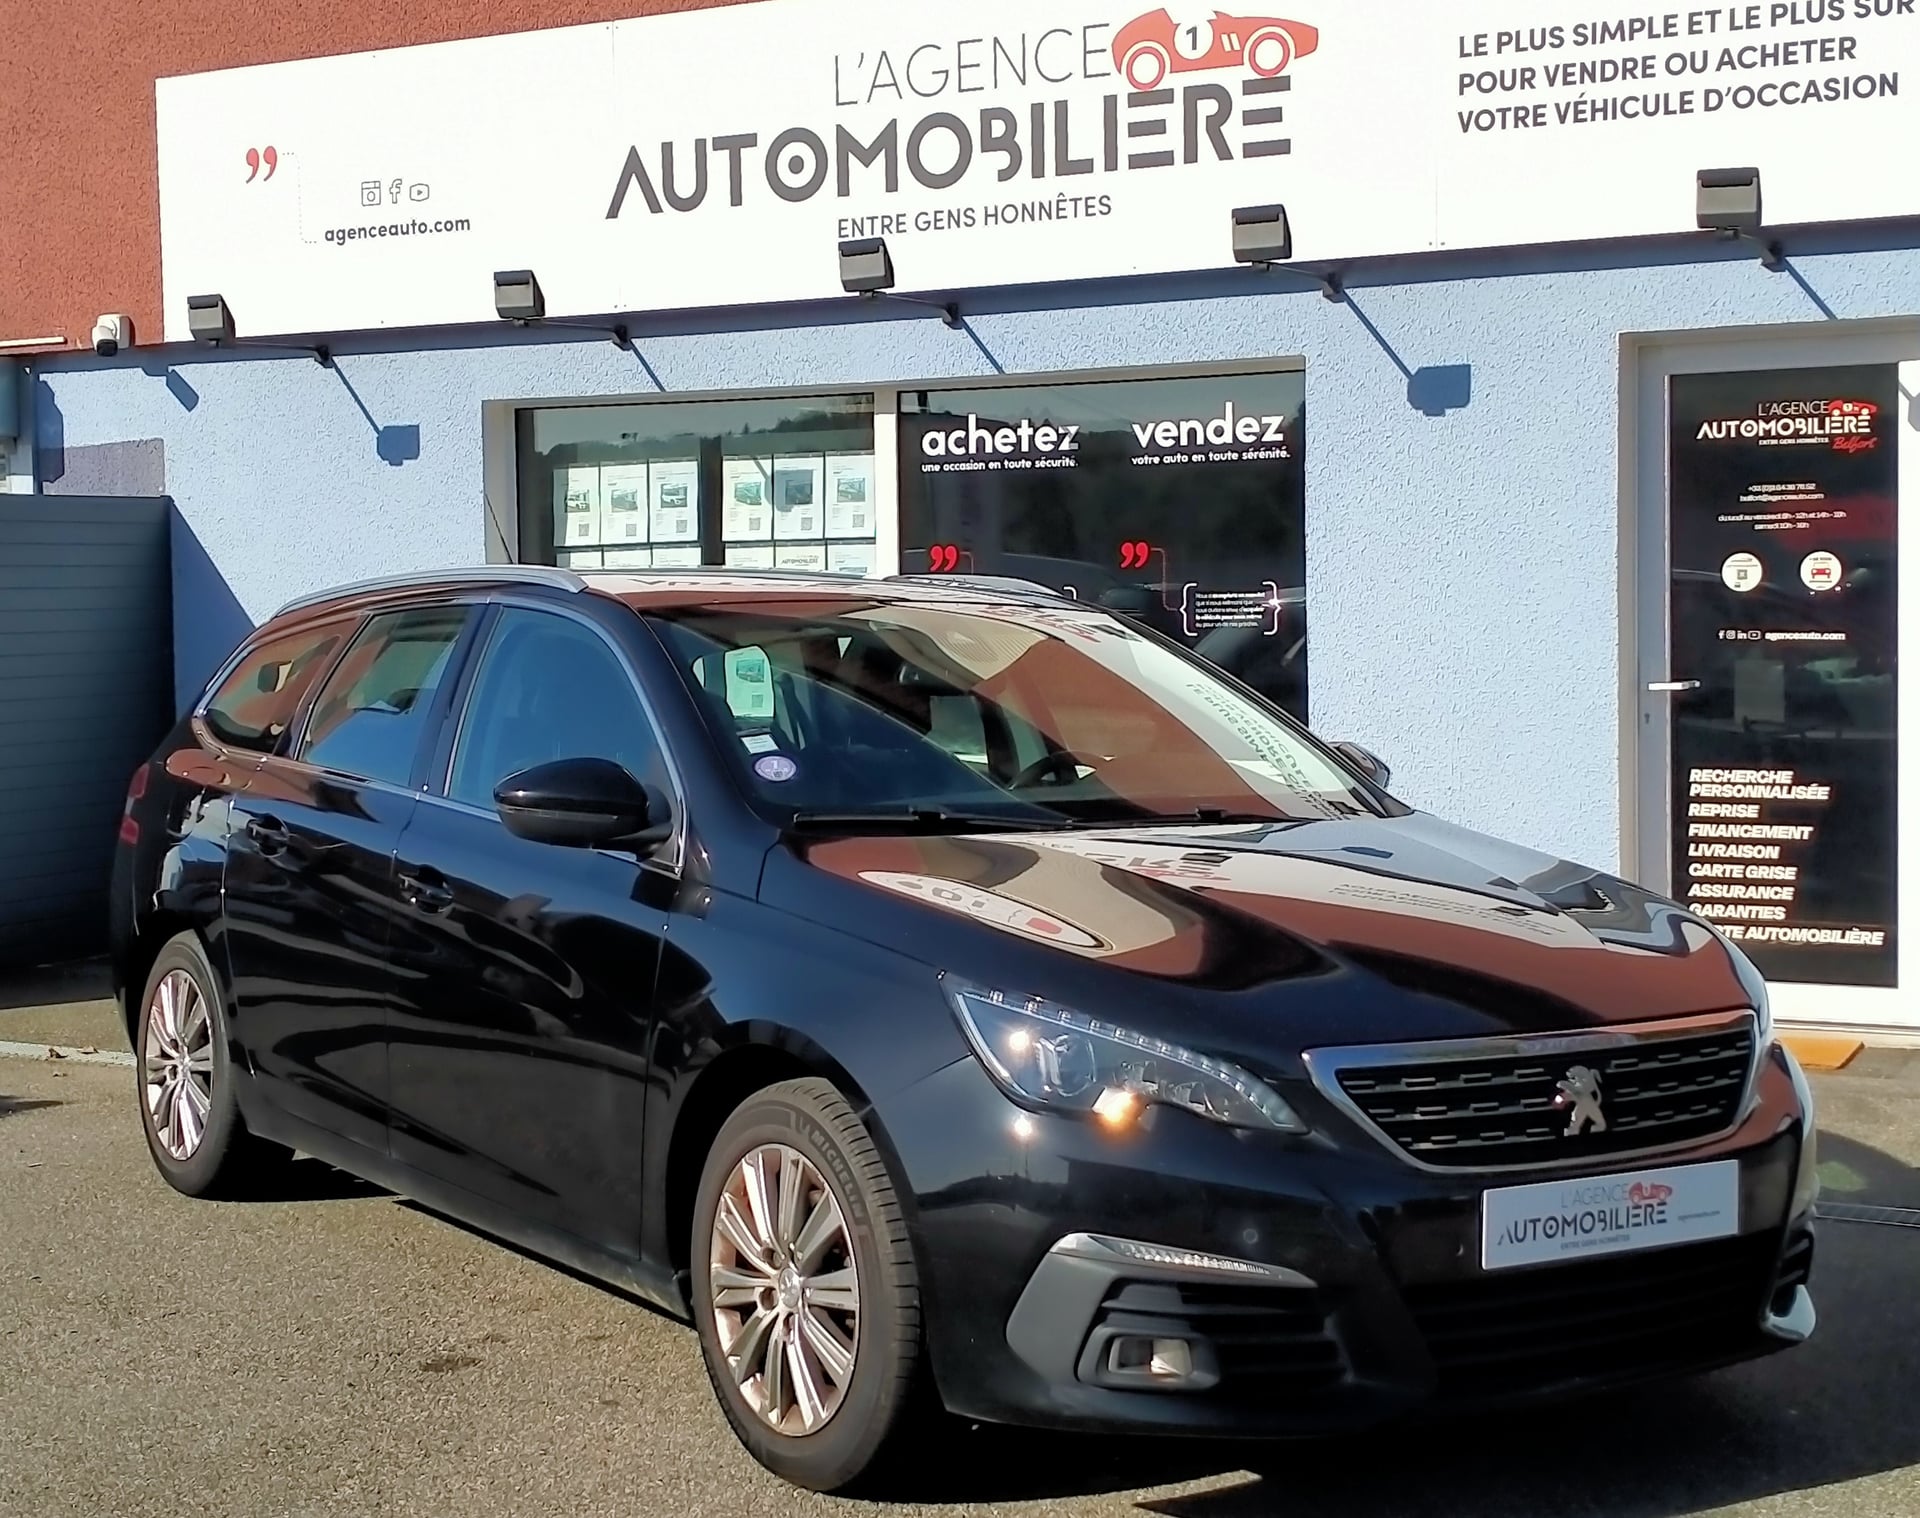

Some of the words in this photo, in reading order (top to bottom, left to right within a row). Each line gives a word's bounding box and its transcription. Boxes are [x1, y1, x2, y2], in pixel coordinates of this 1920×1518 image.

[1459, 33, 1489, 58] LE
[1496, 27, 1565, 54] PLUS
[1572, 14, 1679, 48] SIMPLE
[1687, 9, 1722, 36] ET
[1729, 5, 1762, 32] LE
[1770, 0, 1845, 28] PLUS
[834, 24, 1111, 107] L'AGENCE
[1458, 67, 1537, 96] POUR
[1543, 55, 1657, 87] VENDRE
[1664, 50, 1709, 76] OU
[1715, 36, 1857, 72] ACHETER
[1457, 104, 1548, 134] VOTRE
[1554, 91, 1695, 125] VÉHICULE
[838, 213, 907, 239] ENTRE
[914, 207, 976, 232] GENS
[984, 192, 1112, 226] HONNÊTES
[324, 218, 471, 246] agenceauto.com
[1758, 400, 1829, 416] L'AGENCE
[1132, 401, 1285, 448] vendez
[922, 413, 1080, 457] achetez
[921, 463, 941, 473] une
[943, 460, 986, 472] occasion
[988, 461, 1001, 470] en
[1003, 458, 1032, 469] toute
[1034, 455, 1079, 469] sécurité.
[1131, 454, 1160, 465] votre
[1163, 452, 1189, 464] auto
[1191, 454, 1206, 463] en
[1208, 450, 1239, 461] toute
[1242, 446, 1291, 460] sérénité.
[1688, 769, 1795, 784] RECHERCHE
[1689, 783, 1832, 800] PERSONNALISÉE
[1688, 803, 1761, 818] REPRISE
[1688, 823, 1815, 840] FINANCEMENT
[1688, 843, 1781, 859] LIVRAISON
[1688, 864, 1745, 878] CARTE
[1745, 866, 1798, 880] GRISE
[1687, 884, 1796, 900] ASSURANCE
[1688, 903, 1787, 920] GARANTIES
[1744, 925, 1885, 945] AUTOMOBILIÈRE
[810, 1130, 864, 1219] MICHELIN
[1560, 1183, 1630, 1209] L'AGENCE
